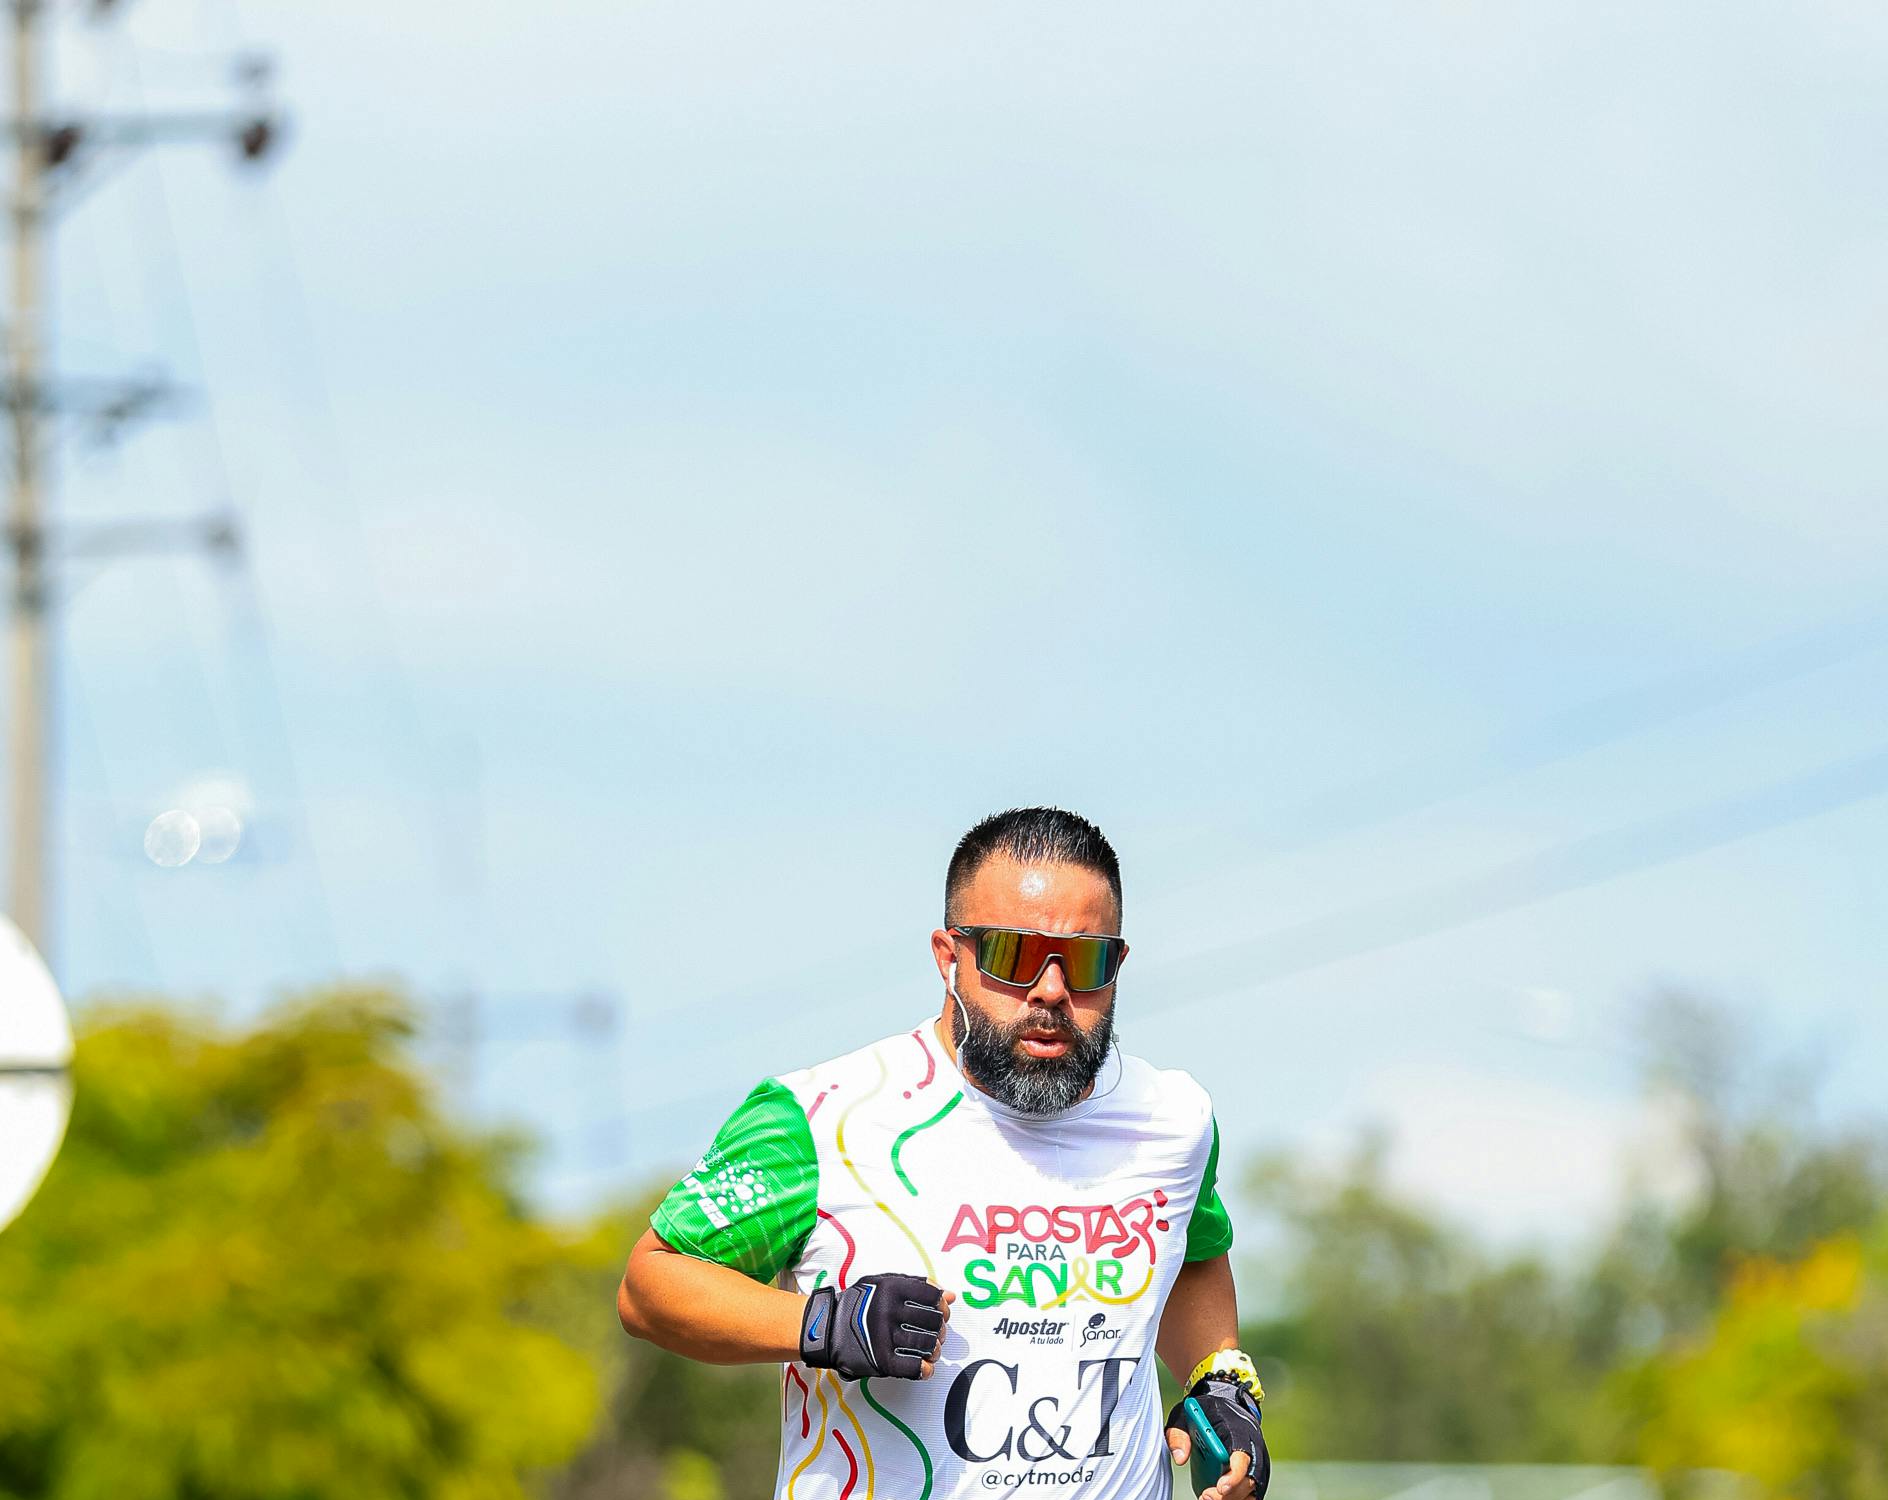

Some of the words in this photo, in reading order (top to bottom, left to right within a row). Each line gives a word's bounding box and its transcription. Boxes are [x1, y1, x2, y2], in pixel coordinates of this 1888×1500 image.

[941, 1198, 1156, 1265] APOSTAR
[1007, 1243, 1066, 1261] PARA
[962, 1257, 1124, 1310] SANAR
[993, 1317, 1066, 1337] Apostar
[1046, 1337, 1064, 1345] lado
[944, 1358, 1142, 1463] C&T
[981, 1467, 1094, 1490] @cytmoda
